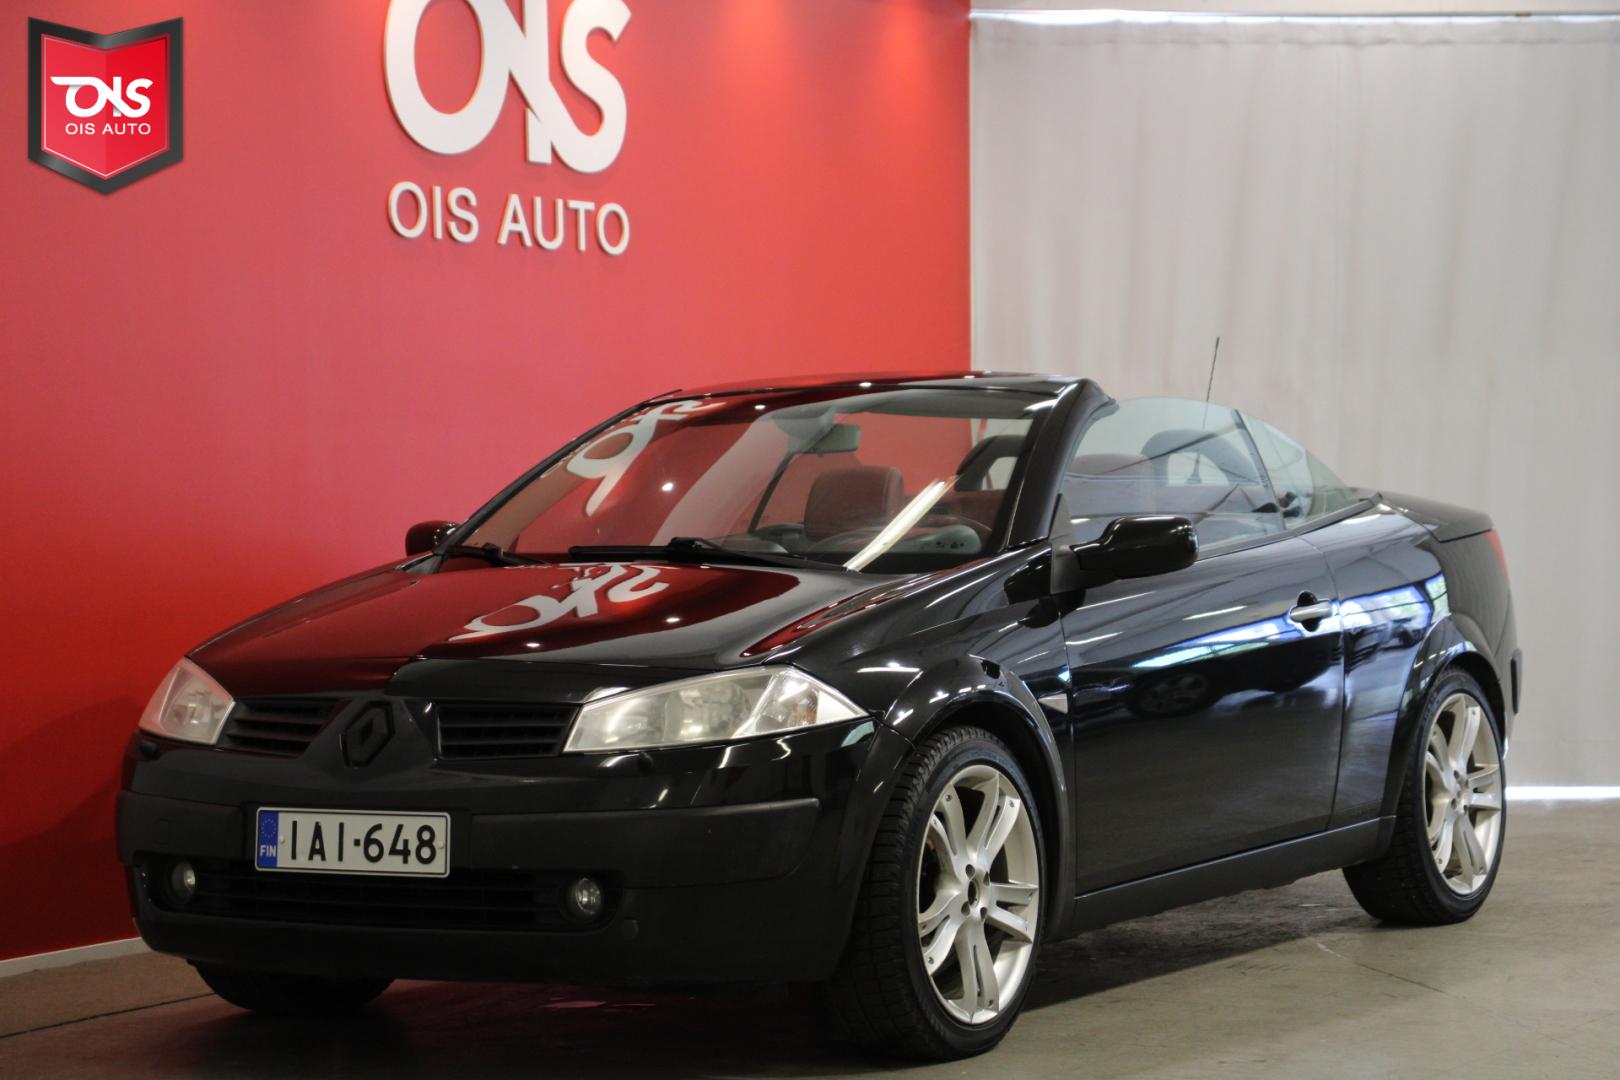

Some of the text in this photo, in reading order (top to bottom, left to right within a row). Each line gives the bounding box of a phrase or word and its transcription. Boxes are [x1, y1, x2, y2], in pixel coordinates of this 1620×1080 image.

[384, 0, 632, 174] OIS
[388, 180, 631, 256] OIS AUTO
[259, 819, 437, 865] FIN IAI-648
